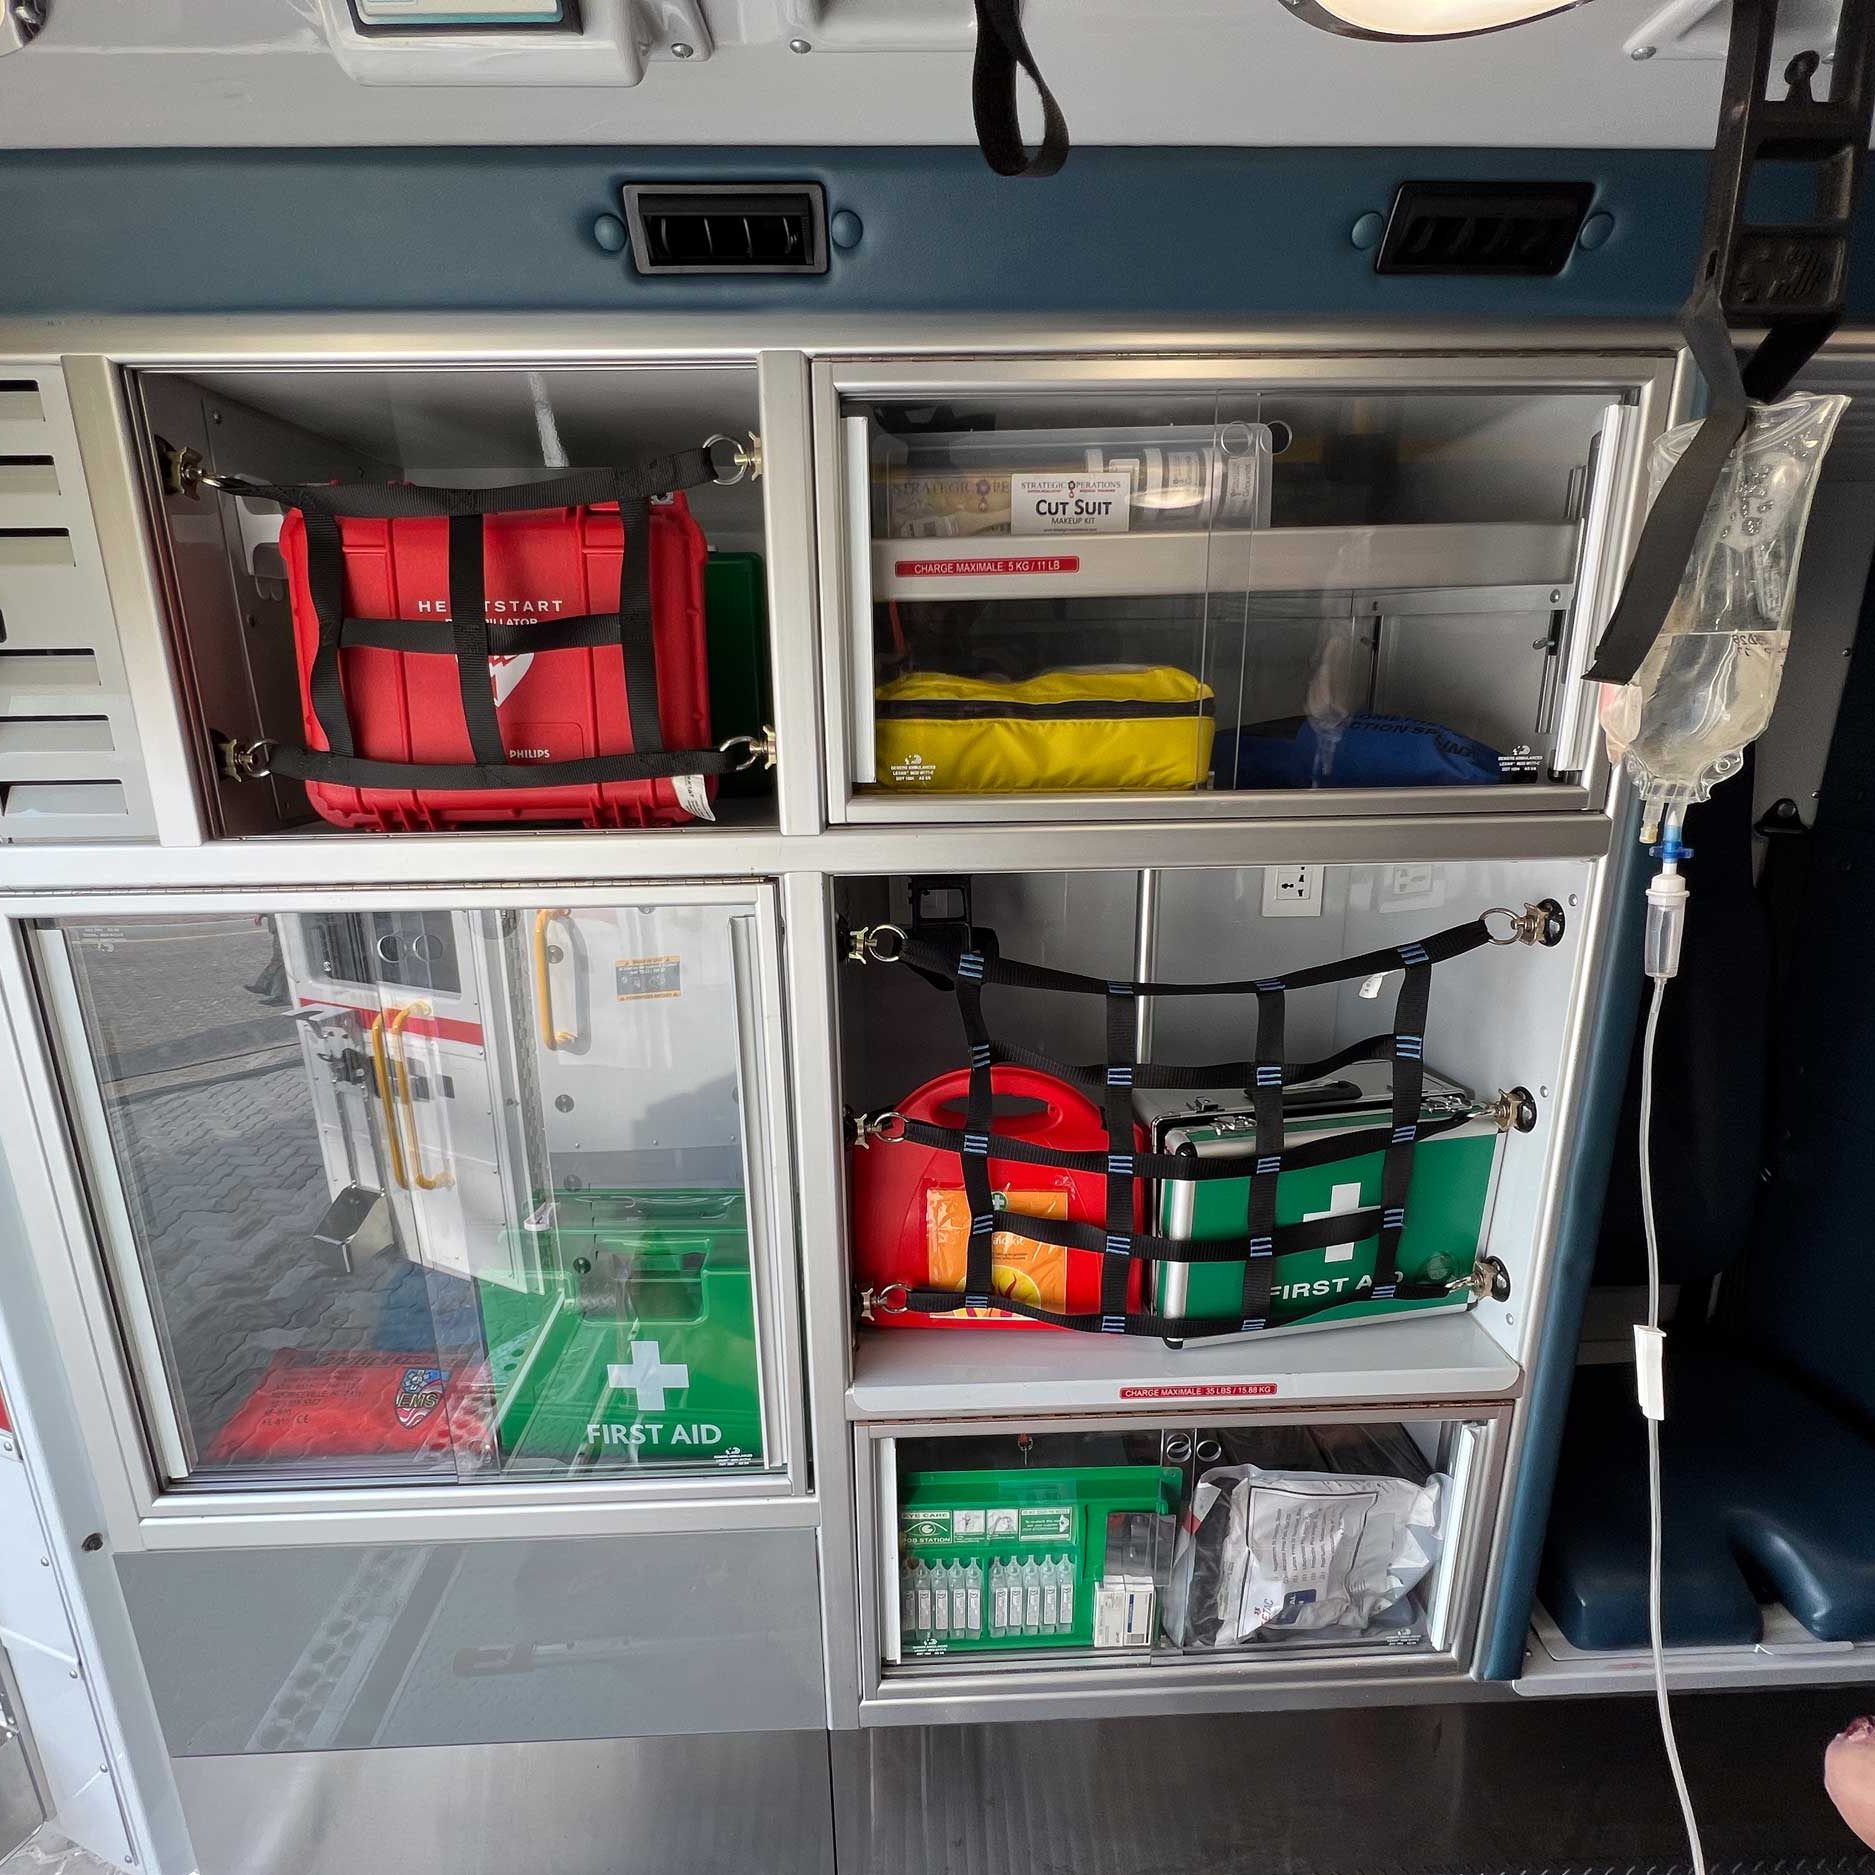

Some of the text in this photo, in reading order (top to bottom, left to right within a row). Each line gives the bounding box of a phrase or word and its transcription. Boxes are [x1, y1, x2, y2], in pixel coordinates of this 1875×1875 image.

[1021, 481, 1066, 489] STRATEGIC
[1035, 499, 1112, 516] CUT SUIT
[1051, 517, 1096, 525] MAKEUP KIT
[914, 562, 954, 574] CHARGE
[956, 561, 1004, 574] MAXIMALE
[1008, 561, 1014, 572] 5
[1015, 561, 1029, 572] KG
[1037, 560, 1046, 571] 11
[1048, 560, 1060, 571] LB
[418, 600, 563, 612] HETSTART
[510, 749, 550, 758] PHILIPS
[1125, 1389, 1159, 1397] CHARGE
[1160, 1388, 1202, 1397] MAXIMALE
[1205, 1387, 1215, 1395] 35
[1216, 1386, 1231, 1395] LBS
[1258, 1386, 1271, 1394] KG
[397, 1392, 439, 1408] EMS
[587, 1424, 722, 1445] FIRST AID
